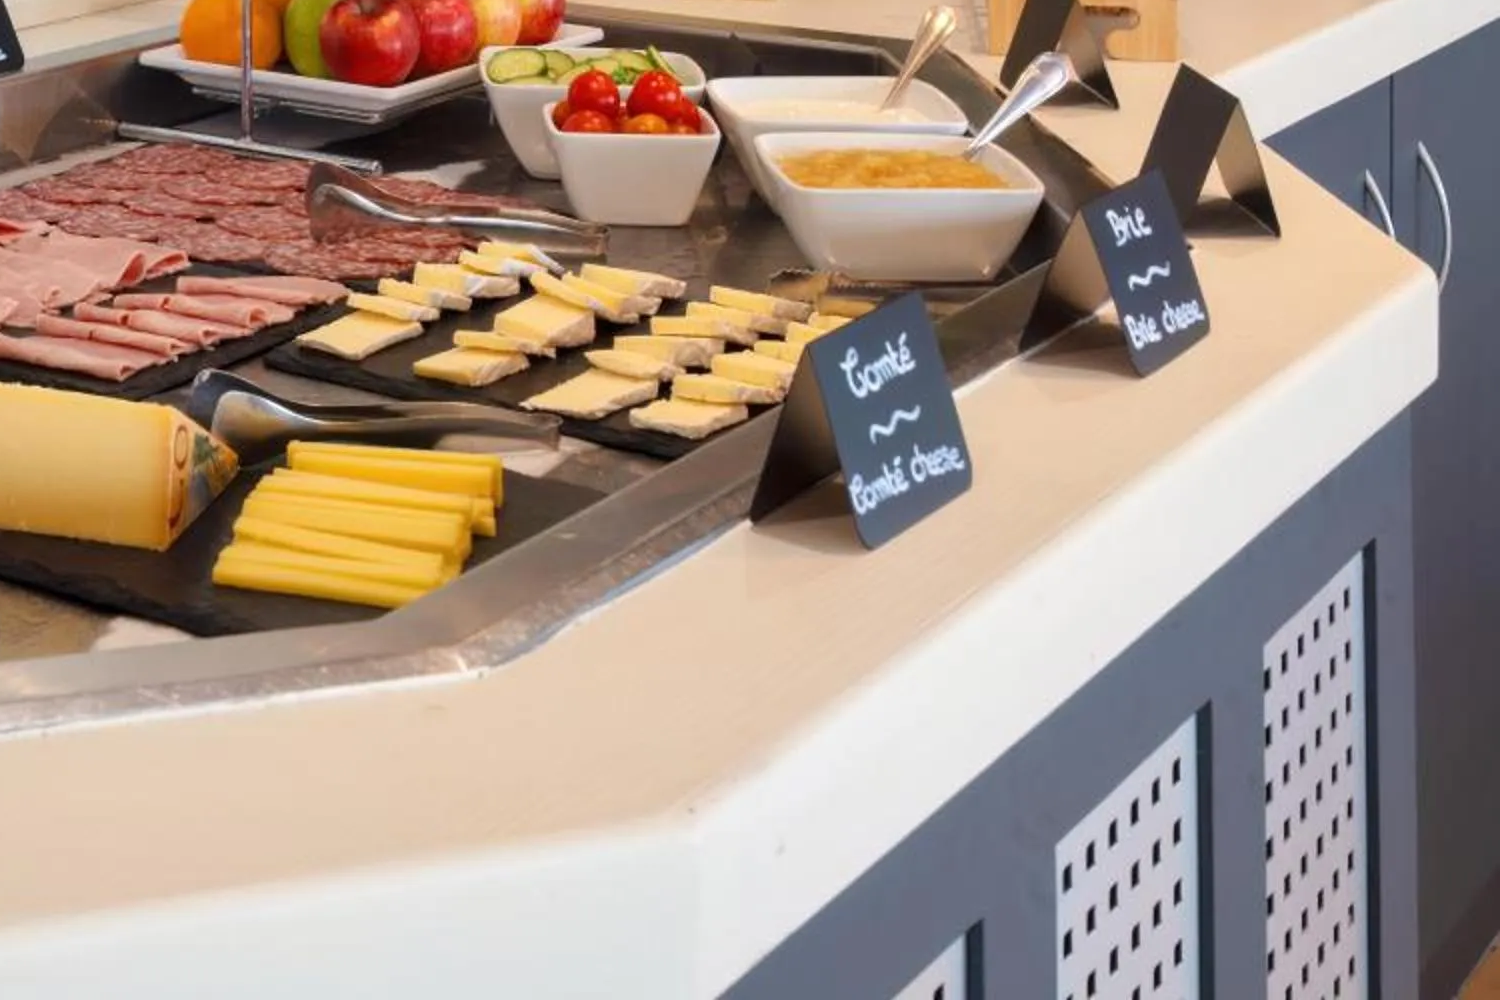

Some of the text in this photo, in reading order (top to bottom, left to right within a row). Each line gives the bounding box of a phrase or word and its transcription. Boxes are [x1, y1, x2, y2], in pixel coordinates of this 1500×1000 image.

[1105, 206, 1153, 247] Brie
[1124, 299, 1205, 351] Brie cheese
[839, 331, 916, 398] Comté
[848, 444, 965, 515] Comté cheese
